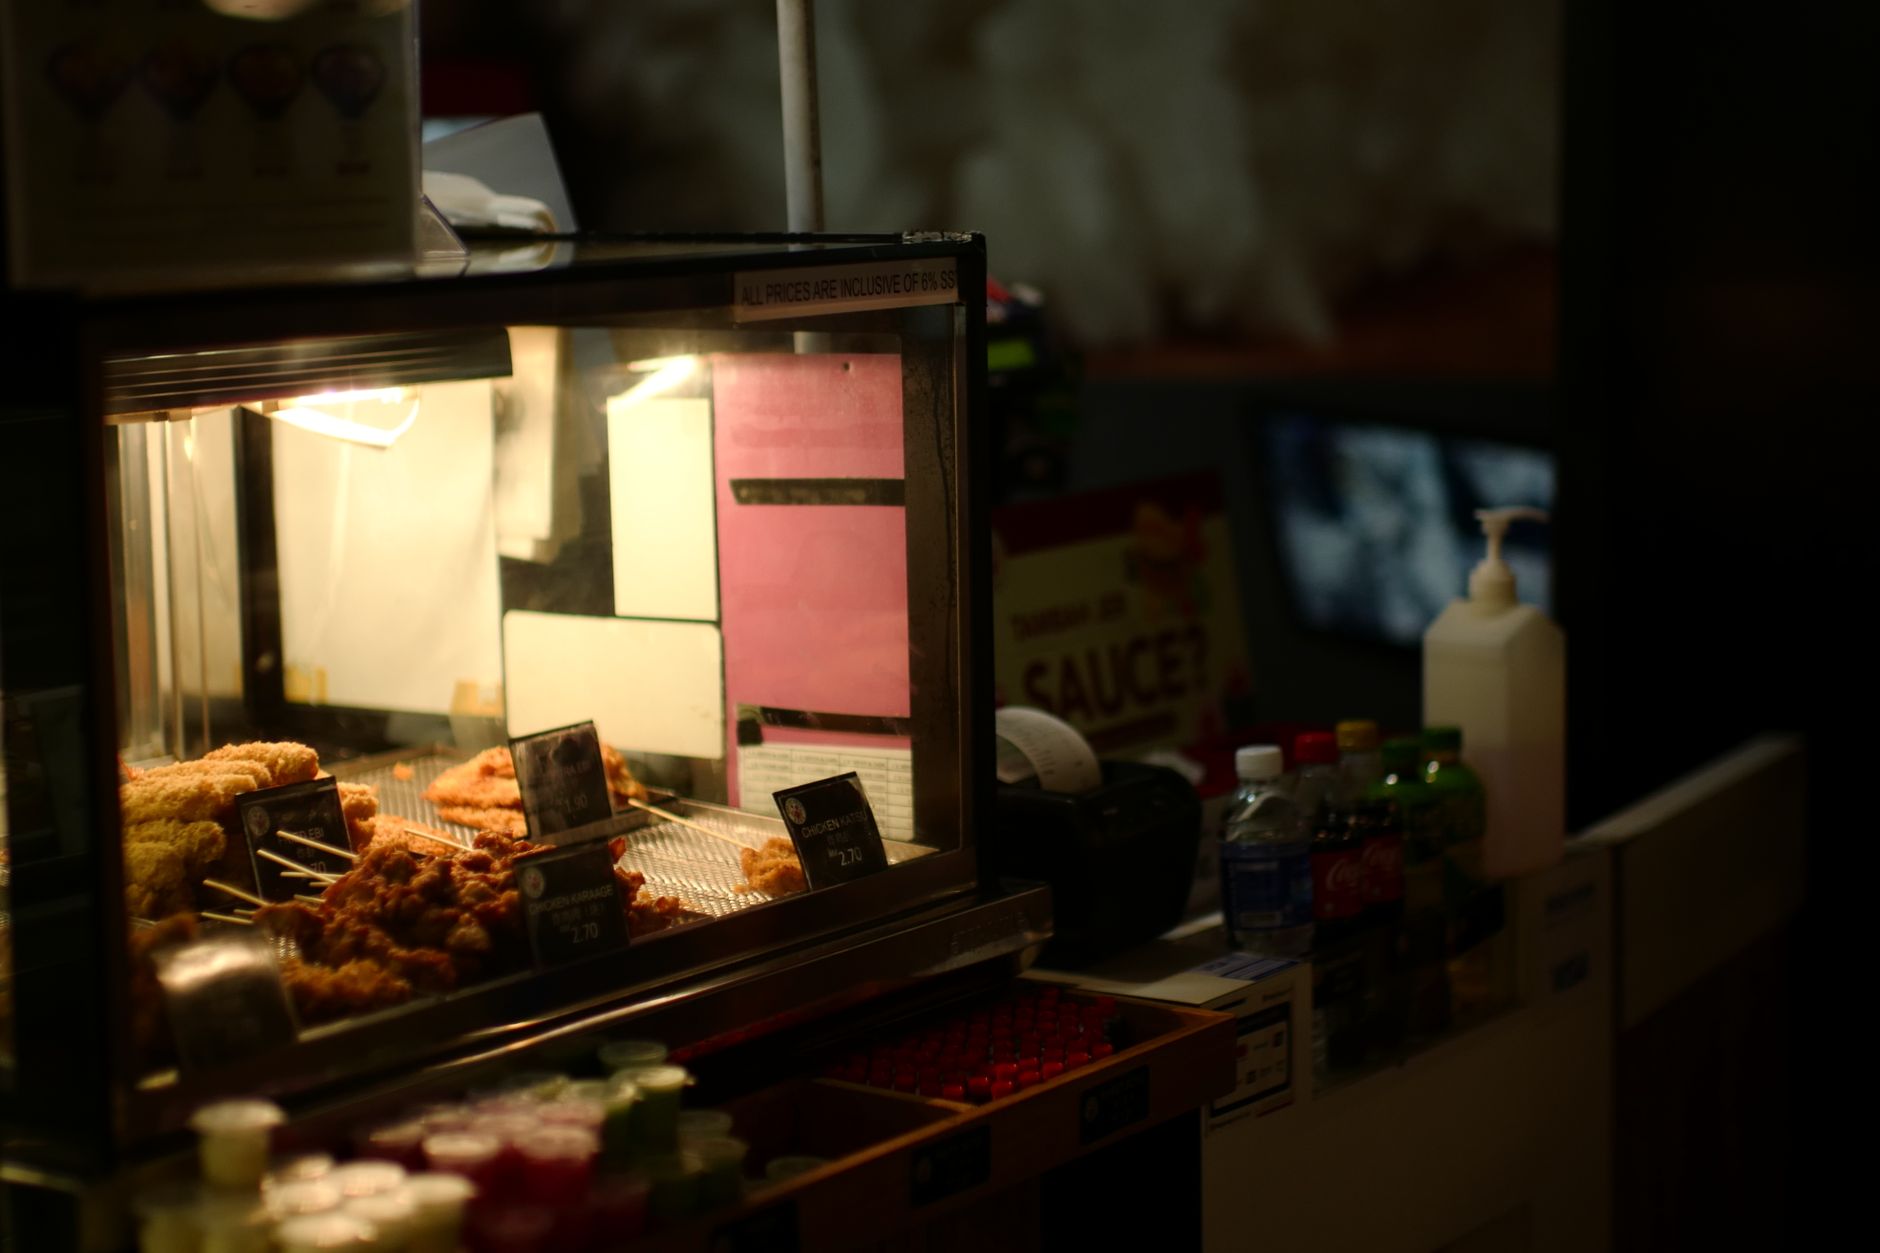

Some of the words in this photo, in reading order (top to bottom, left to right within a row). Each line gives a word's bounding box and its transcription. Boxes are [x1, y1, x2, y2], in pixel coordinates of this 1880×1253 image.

[741, 285, 763, 306] ALL
[766, 281, 810, 304] PRICES
[813, 279, 837, 300] ARE
[840, 274, 901, 298] INCLUSIVE
[903, 272, 919, 293] OF
[921, 271, 938, 292] 6%
[940, 269, 960, 290] SS
[1024, 623, 1208, 721] SAUCE?
[801, 818, 841, 839] CHICKEN
[838, 846, 863, 867] 2.70
[528, 895, 570, 916] CHICKEN
[571, 884, 614, 905] KARAAGE
[570, 921, 599, 944] 2.70
